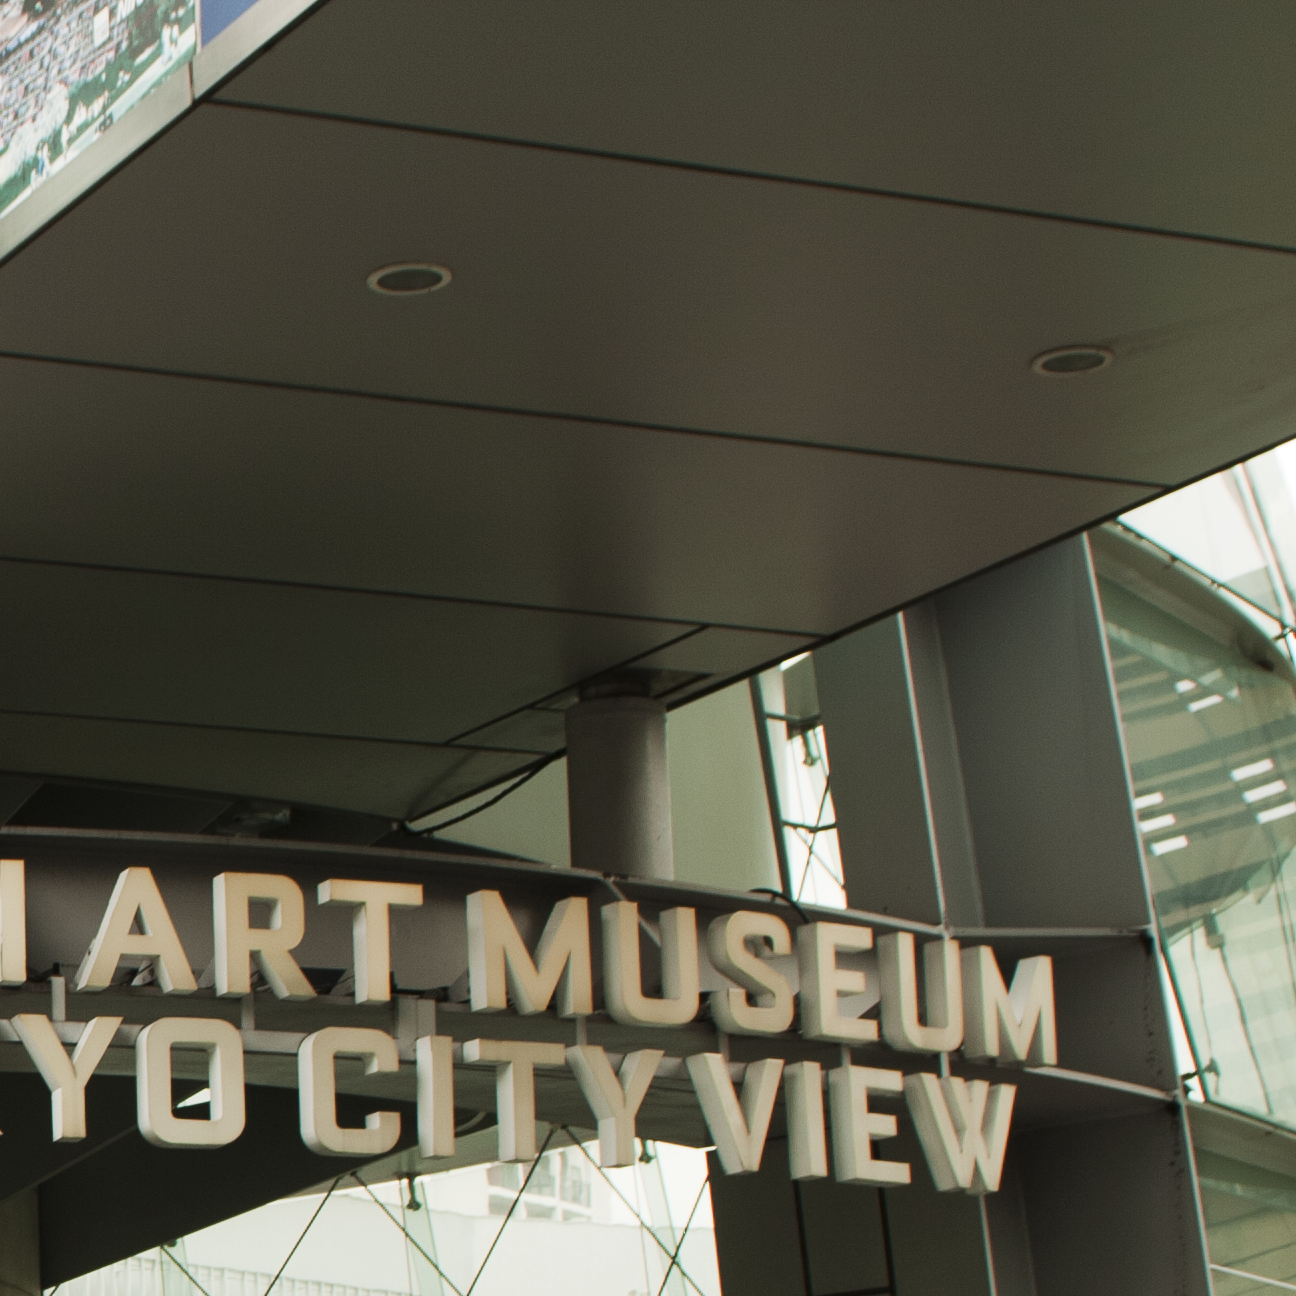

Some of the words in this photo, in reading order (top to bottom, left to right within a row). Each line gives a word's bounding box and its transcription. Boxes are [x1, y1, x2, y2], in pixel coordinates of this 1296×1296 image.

[75, 865, 425, 1003] ART
[465, 889, 1059, 1068] MUSEUM
[297, 1027, 670, 1170] CITY
[685, 1050, 1018, 1195] VIEW
